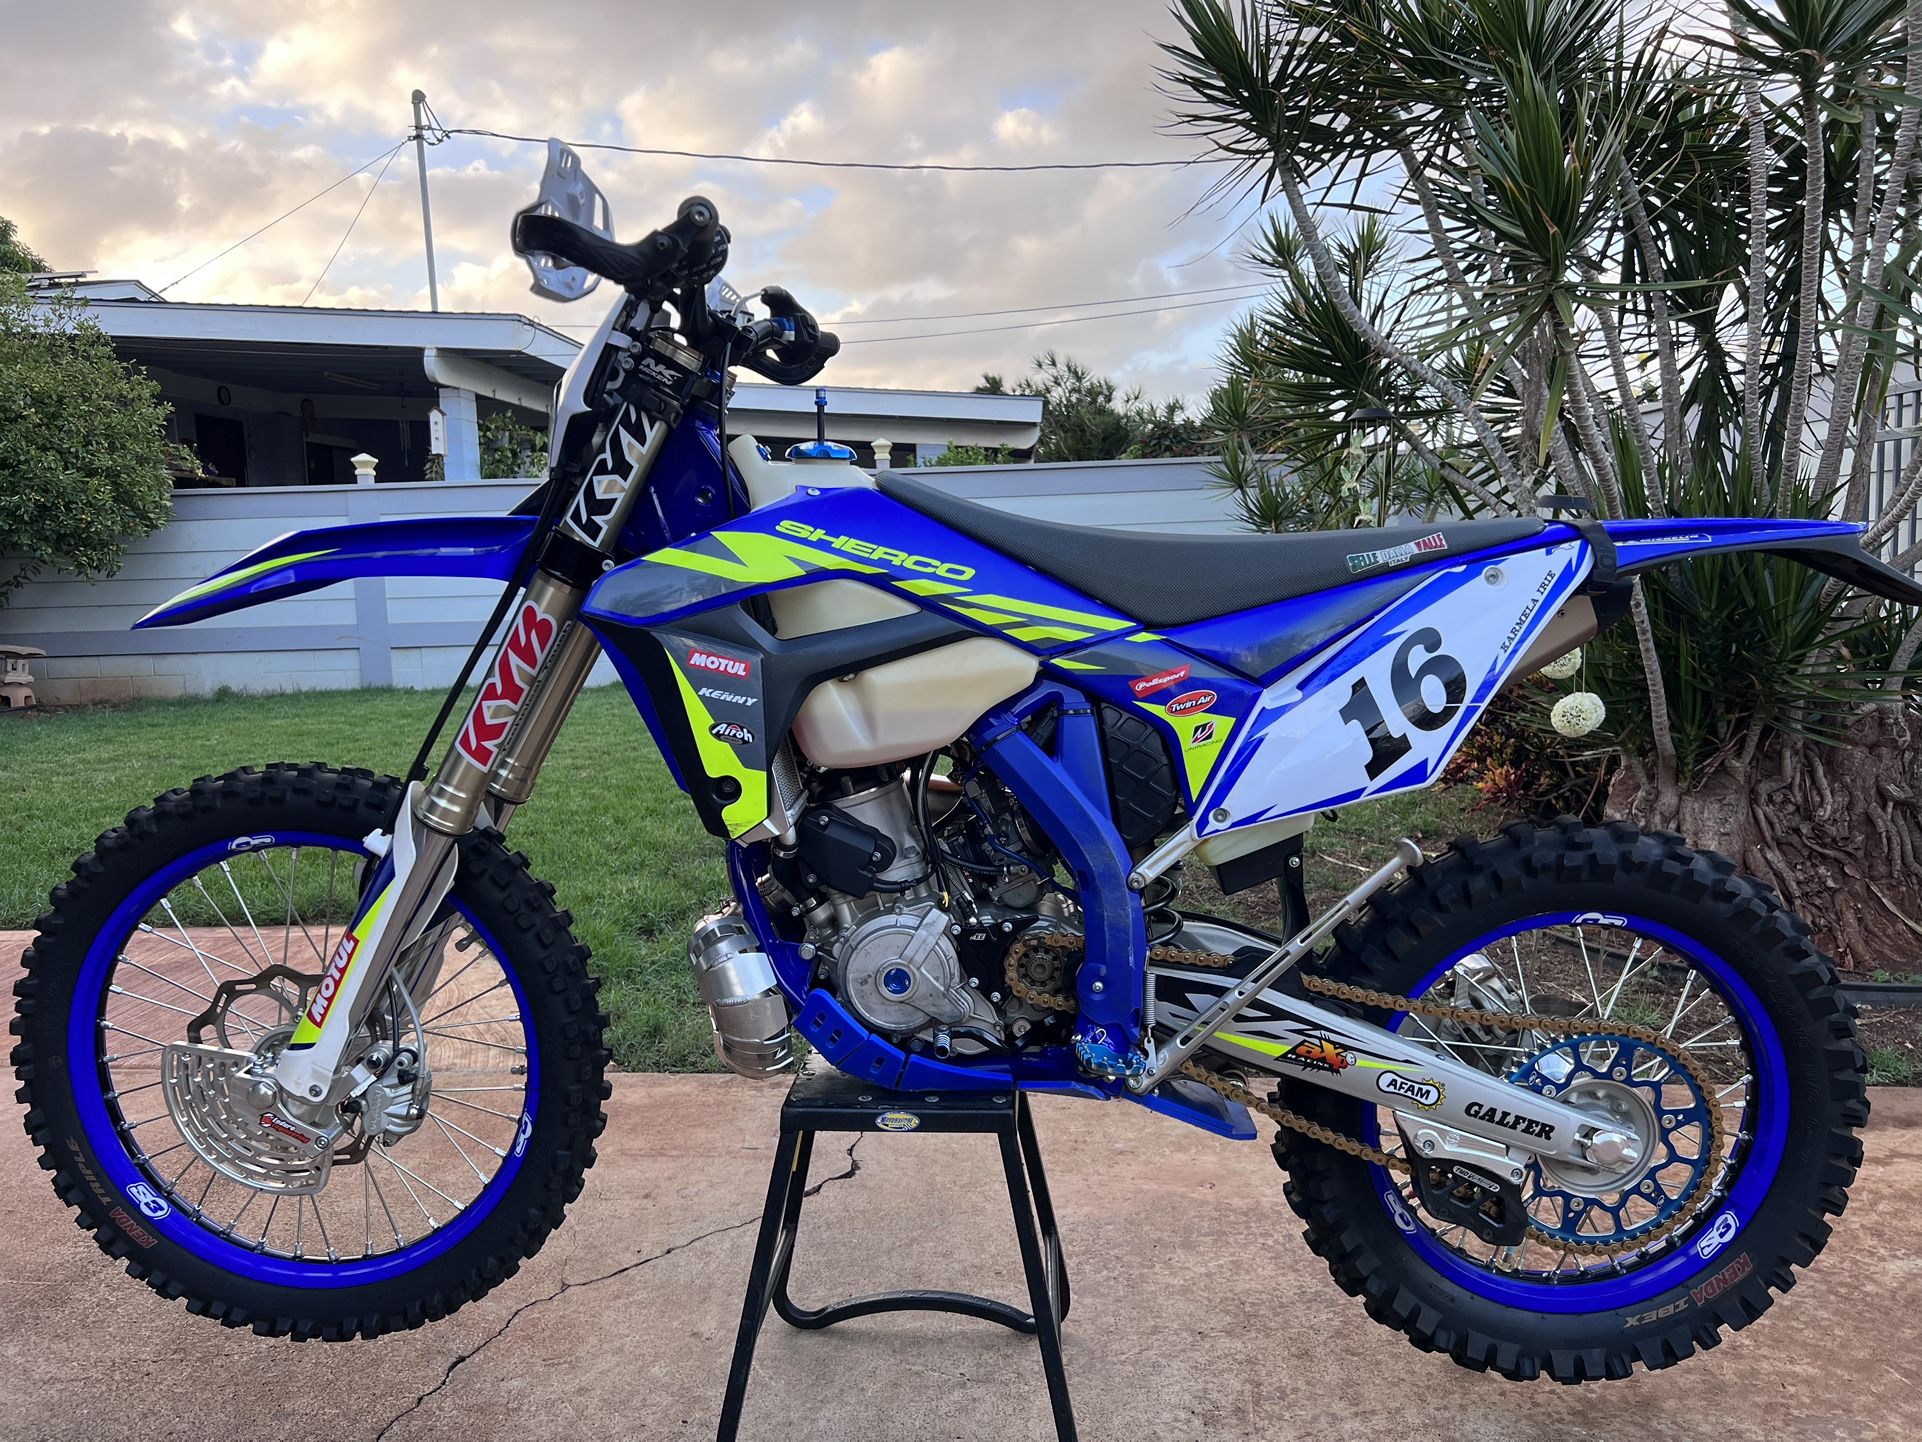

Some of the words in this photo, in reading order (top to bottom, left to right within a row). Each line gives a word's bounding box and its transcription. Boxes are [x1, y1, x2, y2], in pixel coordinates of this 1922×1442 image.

[775, 520, 976, 580] SHERCO
[1348, 553, 1380, 572] SELLE
[1381, 544, 1415, 562] DALLA
[1414, 533, 1446, 552] VALLE
[1389, 556, 1409, 566] ITALY
[1500, 598, 1540, 654] KARMELA
[1536, 570, 1557, 595] IRIE
[690, 653, 747, 676] MOTUL
[1135, 670, 1186, 691] Polisport
[455, 601, 557, 773] KYB
[698, 687, 758, 706] KENNY
[1170, 700, 1196, 712] Twin
[1196, 694, 1214, 706] Air
[1339, 627, 1467, 782] 16
[711, 723, 753, 743] Airoh
[311, 937, 356, 1023] MOTUL
[1287, 1053, 1330, 1068] RACING
[1386, 1076, 1433, 1101] AFAM
[271, 1116, 297, 1132] Enduro
[1464, 1101, 1556, 1141] GALFER
[66, 1136, 113, 1206] TRIPLE
[109, 1206, 159, 1249] KENDA
[1690, 1252, 1754, 1309] KENDA
[1623, 1296, 1690, 1328] IBEX
